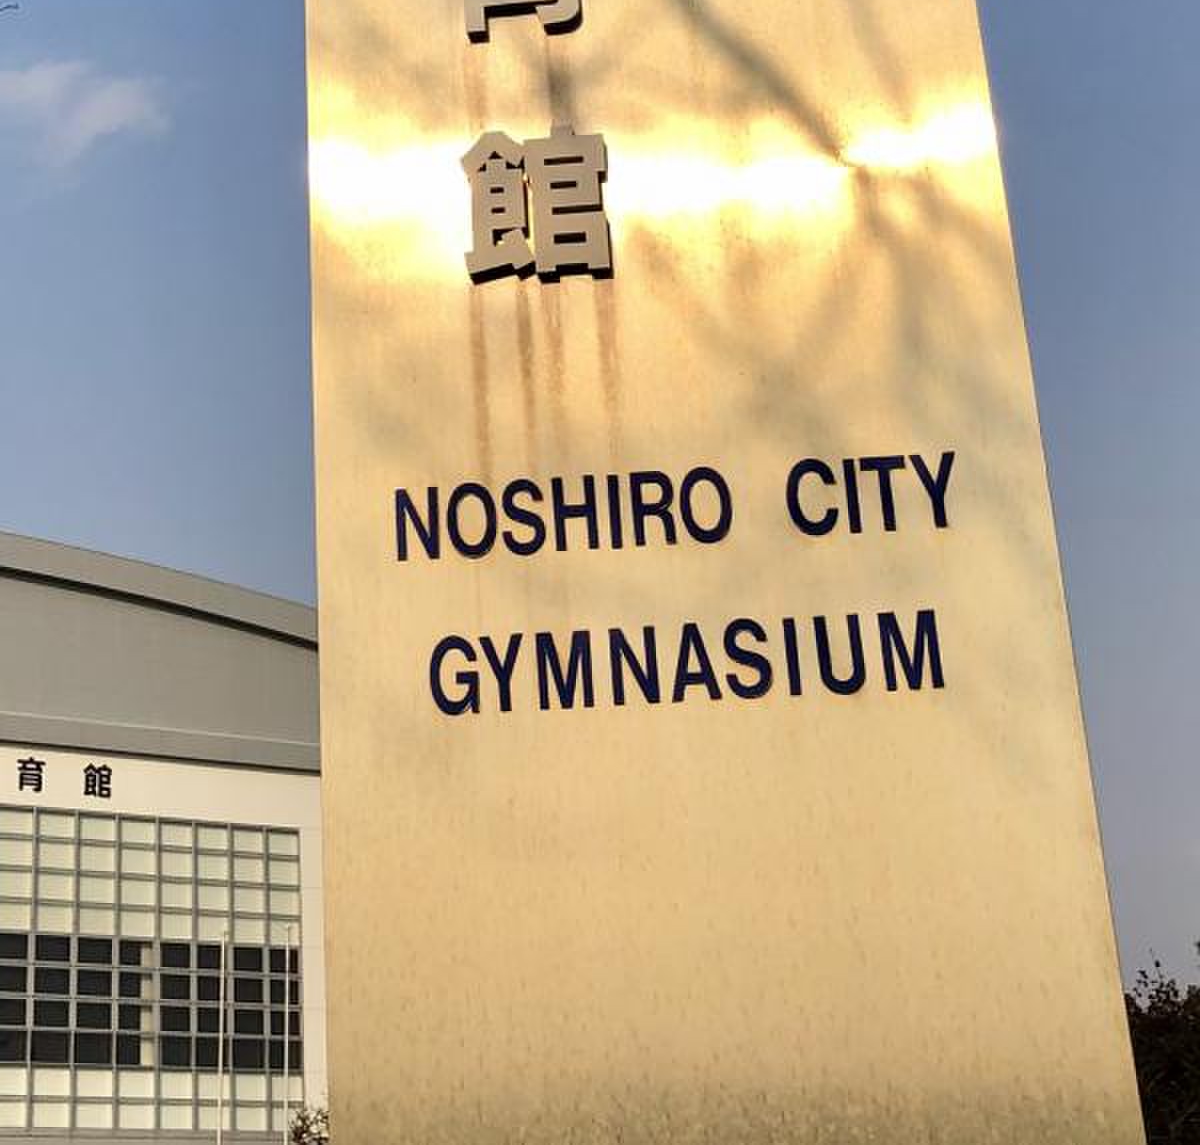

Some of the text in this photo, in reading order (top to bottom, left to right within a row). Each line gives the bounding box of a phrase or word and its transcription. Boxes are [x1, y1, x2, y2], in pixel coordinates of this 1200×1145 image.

[395, 451, 956, 561] NOSHIRO CITY
[429, 609, 946, 716] GYMNASIUM
